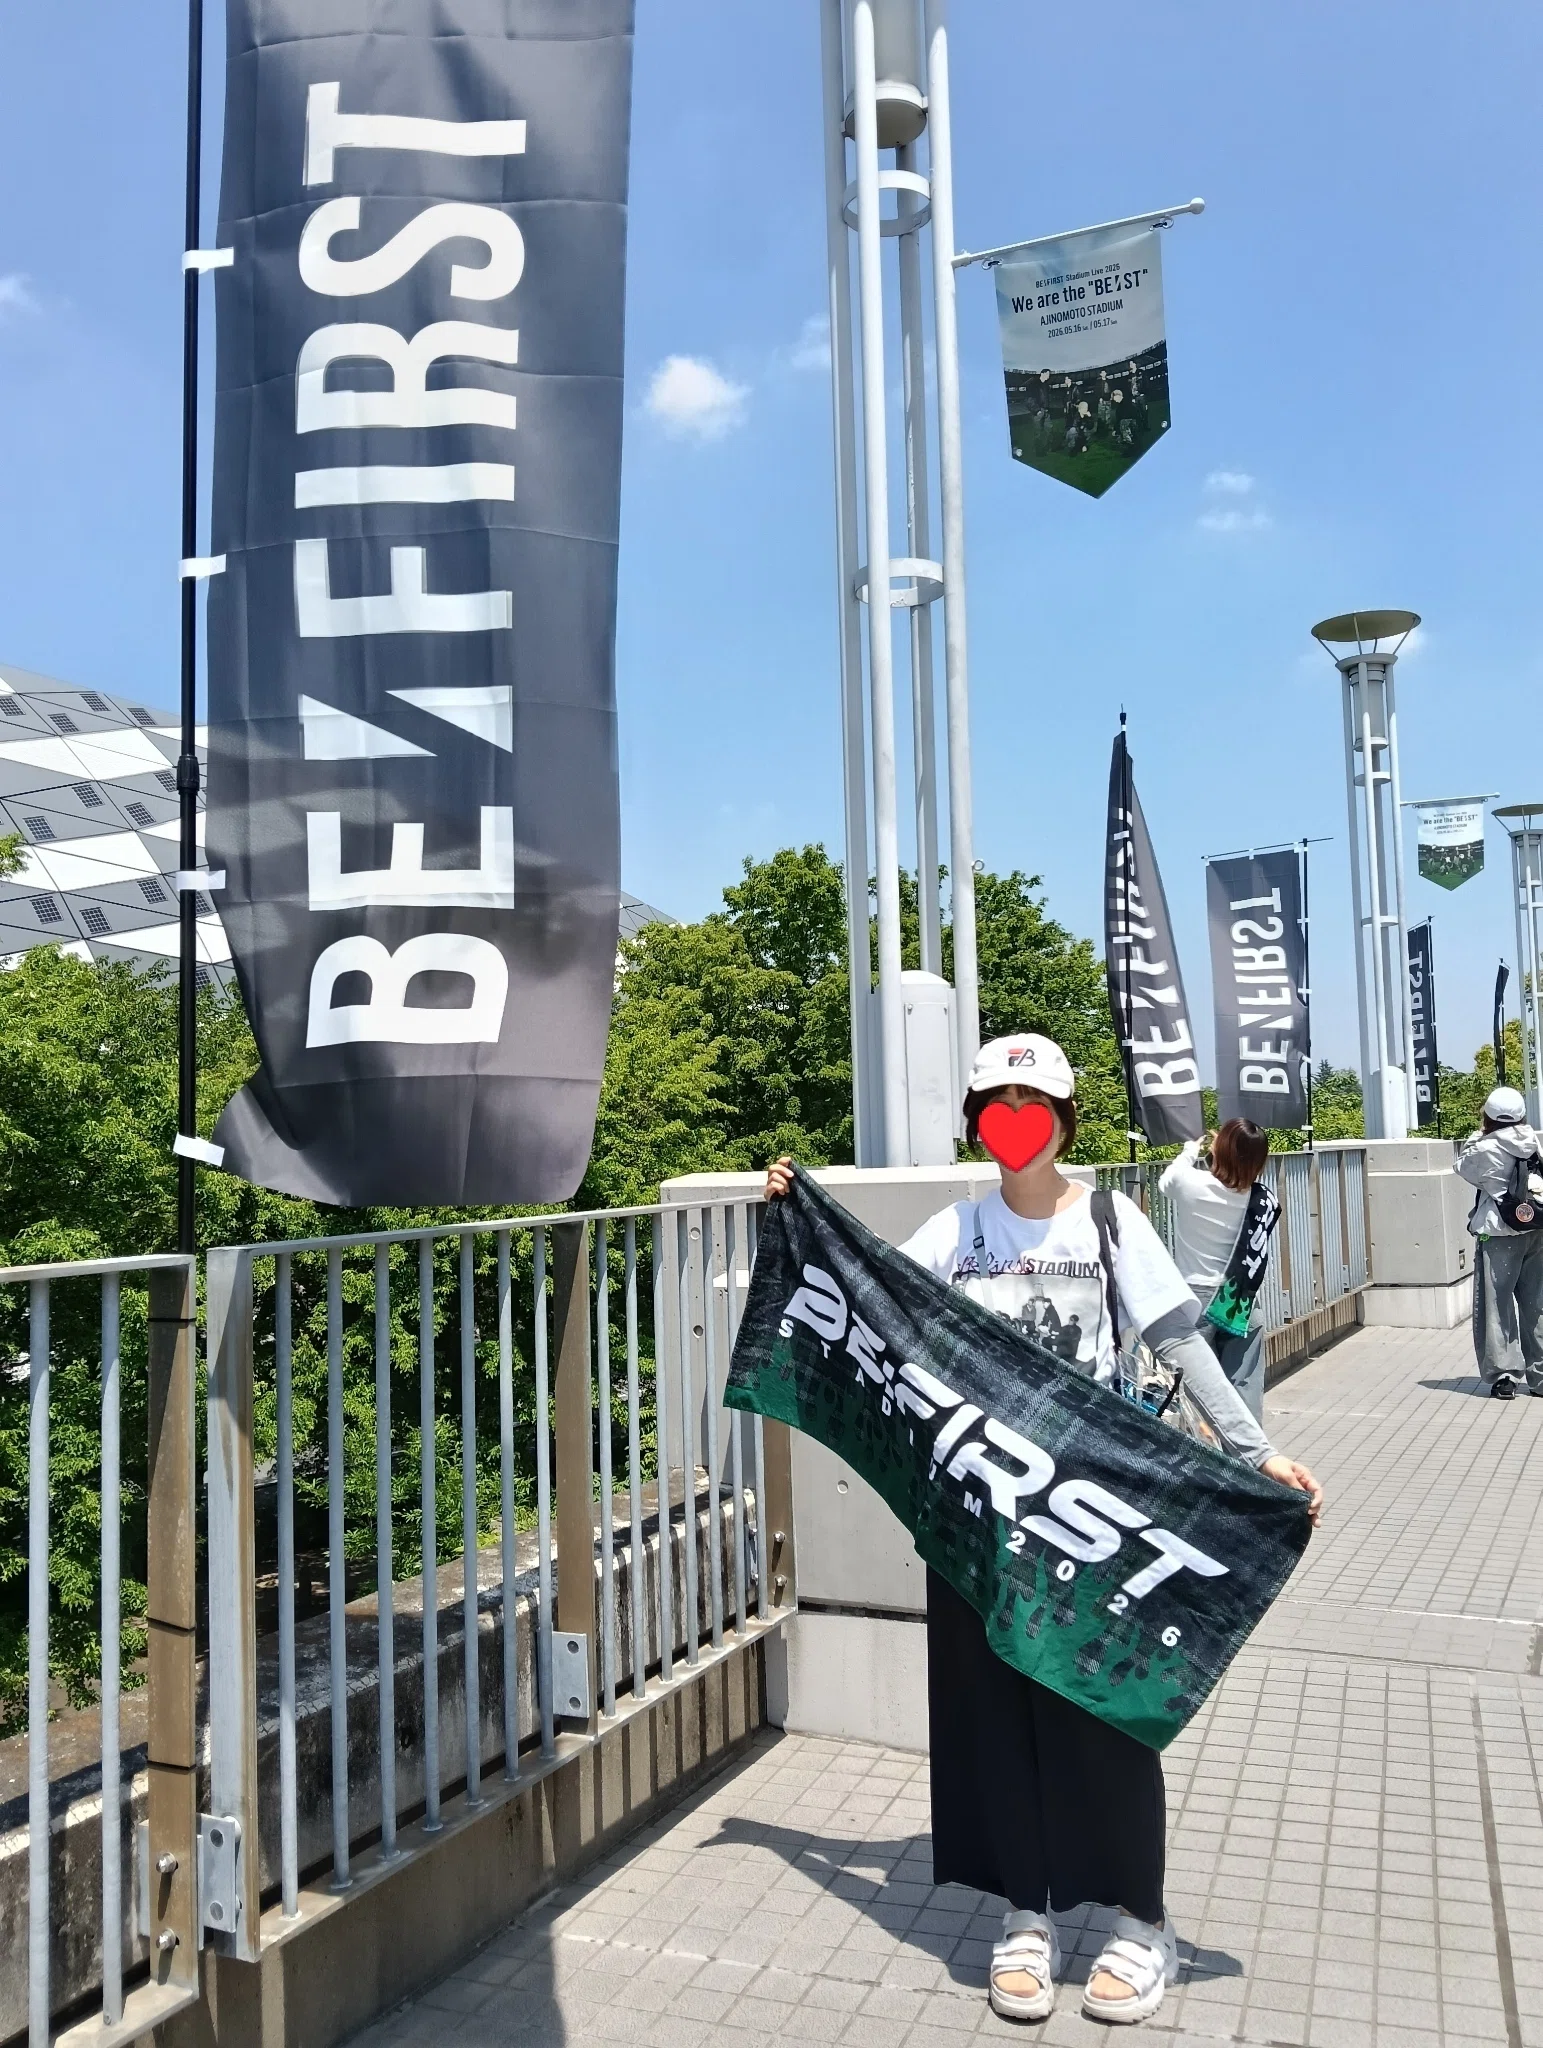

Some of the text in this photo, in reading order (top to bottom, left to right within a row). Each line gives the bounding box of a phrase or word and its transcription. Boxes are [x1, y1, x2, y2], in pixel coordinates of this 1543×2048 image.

[1066, 271, 1090, 282] Stadium
[1091, 268, 1104, 277] Live
[1105, 263, 1120, 274] 2026
[1011, 296, 1034, 314] We
[1037, 291, 1060, 309] are
[1062, 285, 1086, 303] the
[1040, 299, 1124, 326] AJINOMOTO STADIUM
